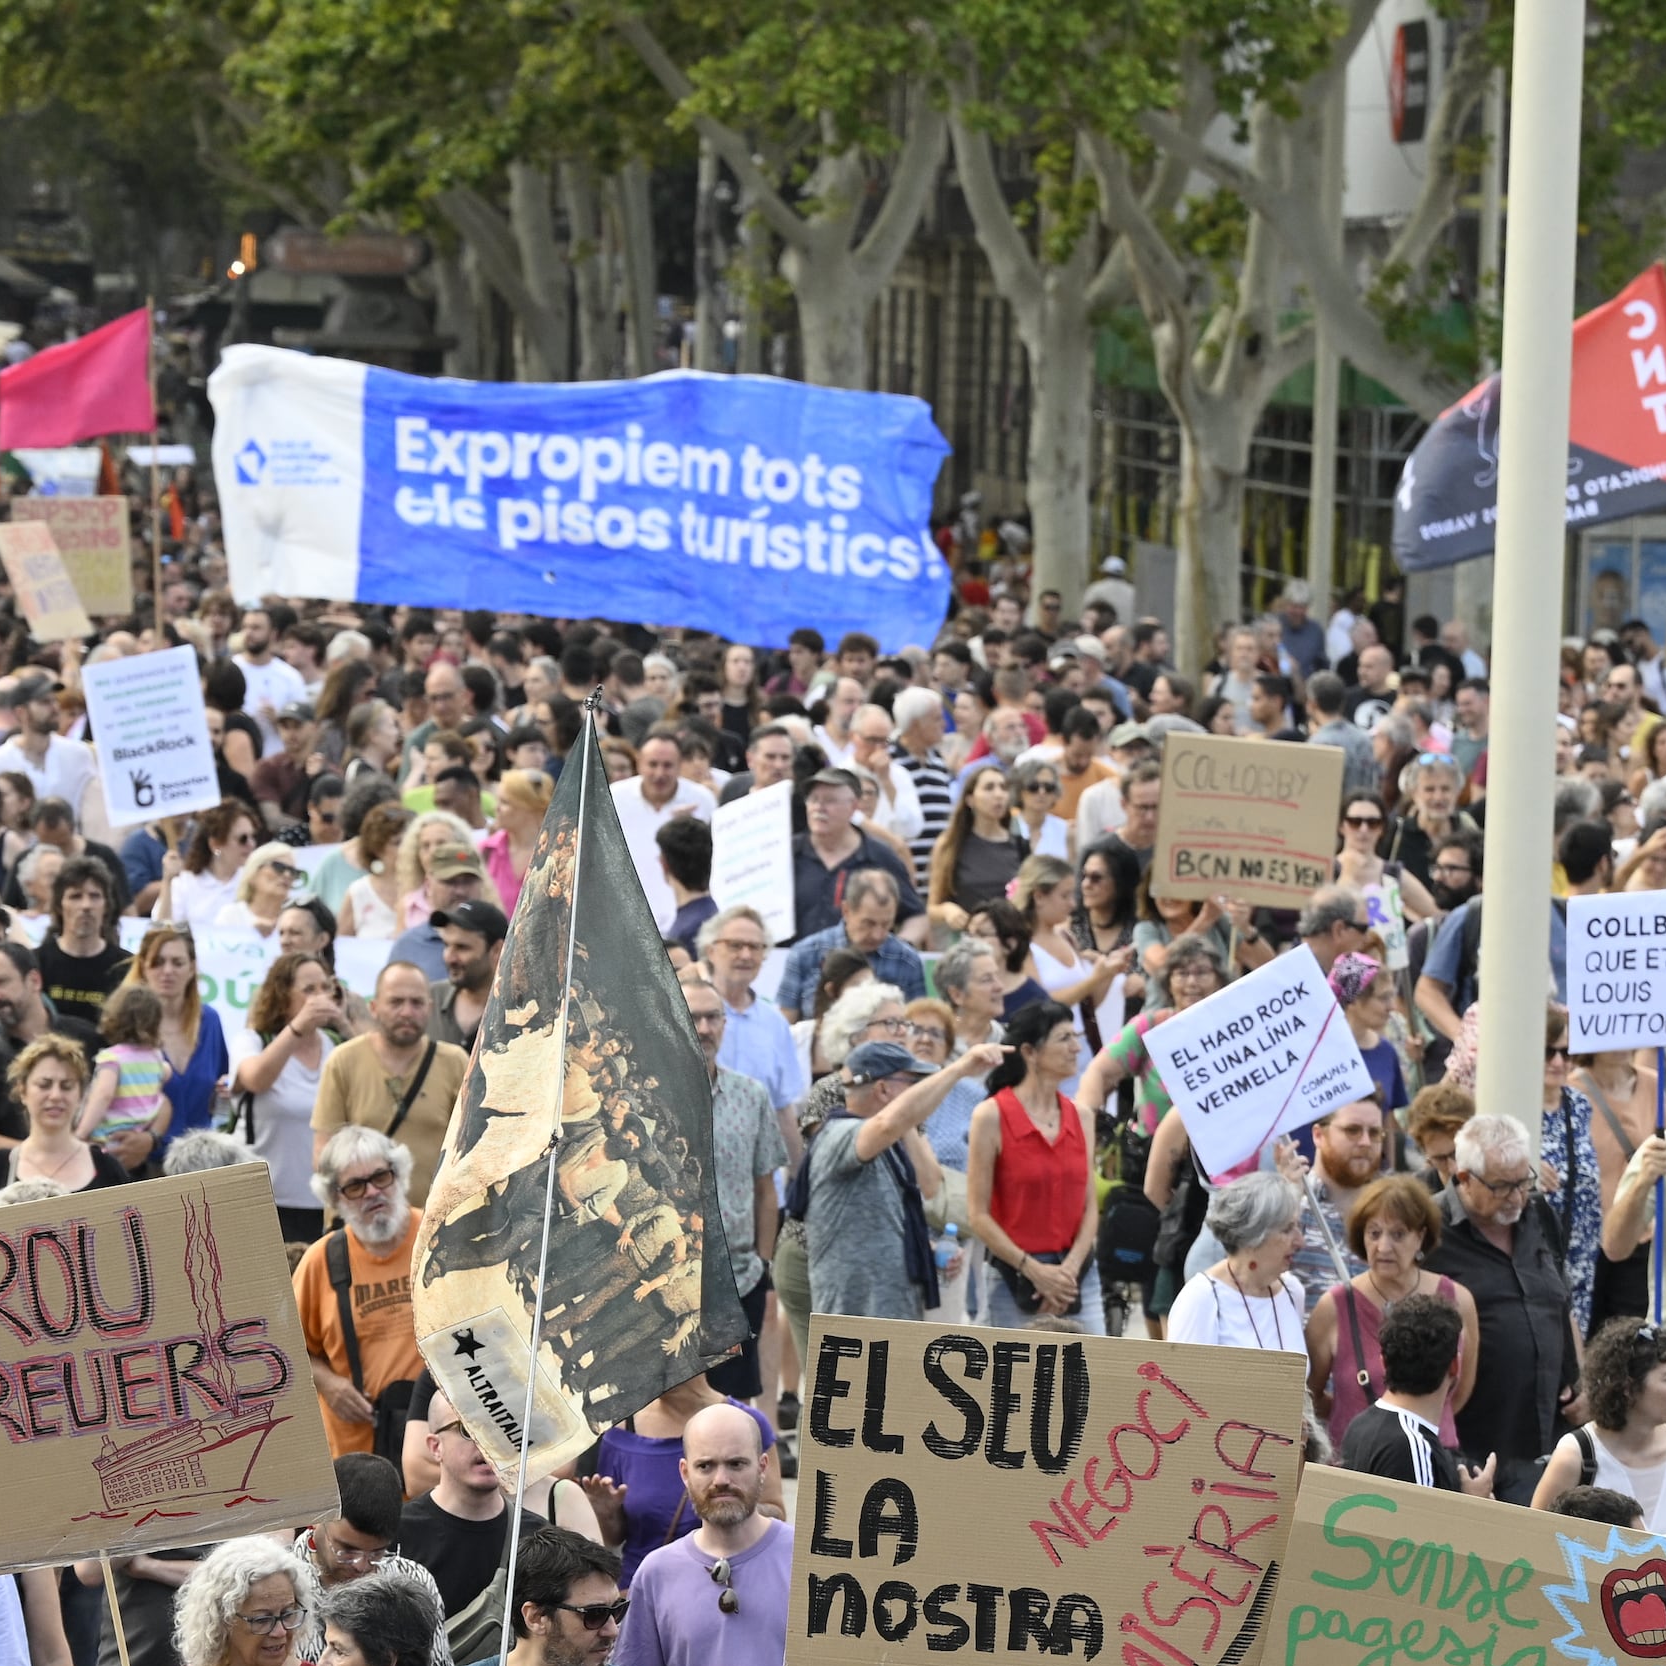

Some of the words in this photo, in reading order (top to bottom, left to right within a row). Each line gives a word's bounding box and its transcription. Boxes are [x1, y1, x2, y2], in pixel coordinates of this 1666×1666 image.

[394, 416, 731, 499] Expropiem
[738, 443, 864, 511] tots
[394, 486, 486, 531] els
[497, 487, 672, 552] pisos
[679, 502, 940, 581] turístics!
[112, 735, 197, 763] BlackRock
[1176, 851, 1230, 879] BCN
[1239, 857, 1263, 878] NO
[1268, 859, 1289, 885] ES
[1582, 981, 1652, 1004] LOUIS
[1585, 949, 1637, 974] QUE
[1170, 1046, 1199, 1070] EL
[1200, 1015, 1255, 1053] HARD
[1256, 981, 1311, 1022] ROCK
[1183, 1066, 1211, 1092] ÉS
[1213, 1044, 1257, 1074] UNA
[1257, 1015, 1307, 1052] LÍNIA
[1196, 1049, 1300, 1115] VERMELLA
[1301, 1064, 1349, 1096] COMUNS
[1350, 1058, 1359, 1070] A
[354, 1275, 411, 1305] MARE
[463, 1364, 534, 1453] ALTRAITALIA
[810, 1333, 906, 1454] EL
[920, 1334, 1091, 1476] SEU
[1027, 1358, 1211, 1569] NEGOCI
[810, 1468, 921, 1566] LA
[1310, 1492, 1539, 1631] Sense
